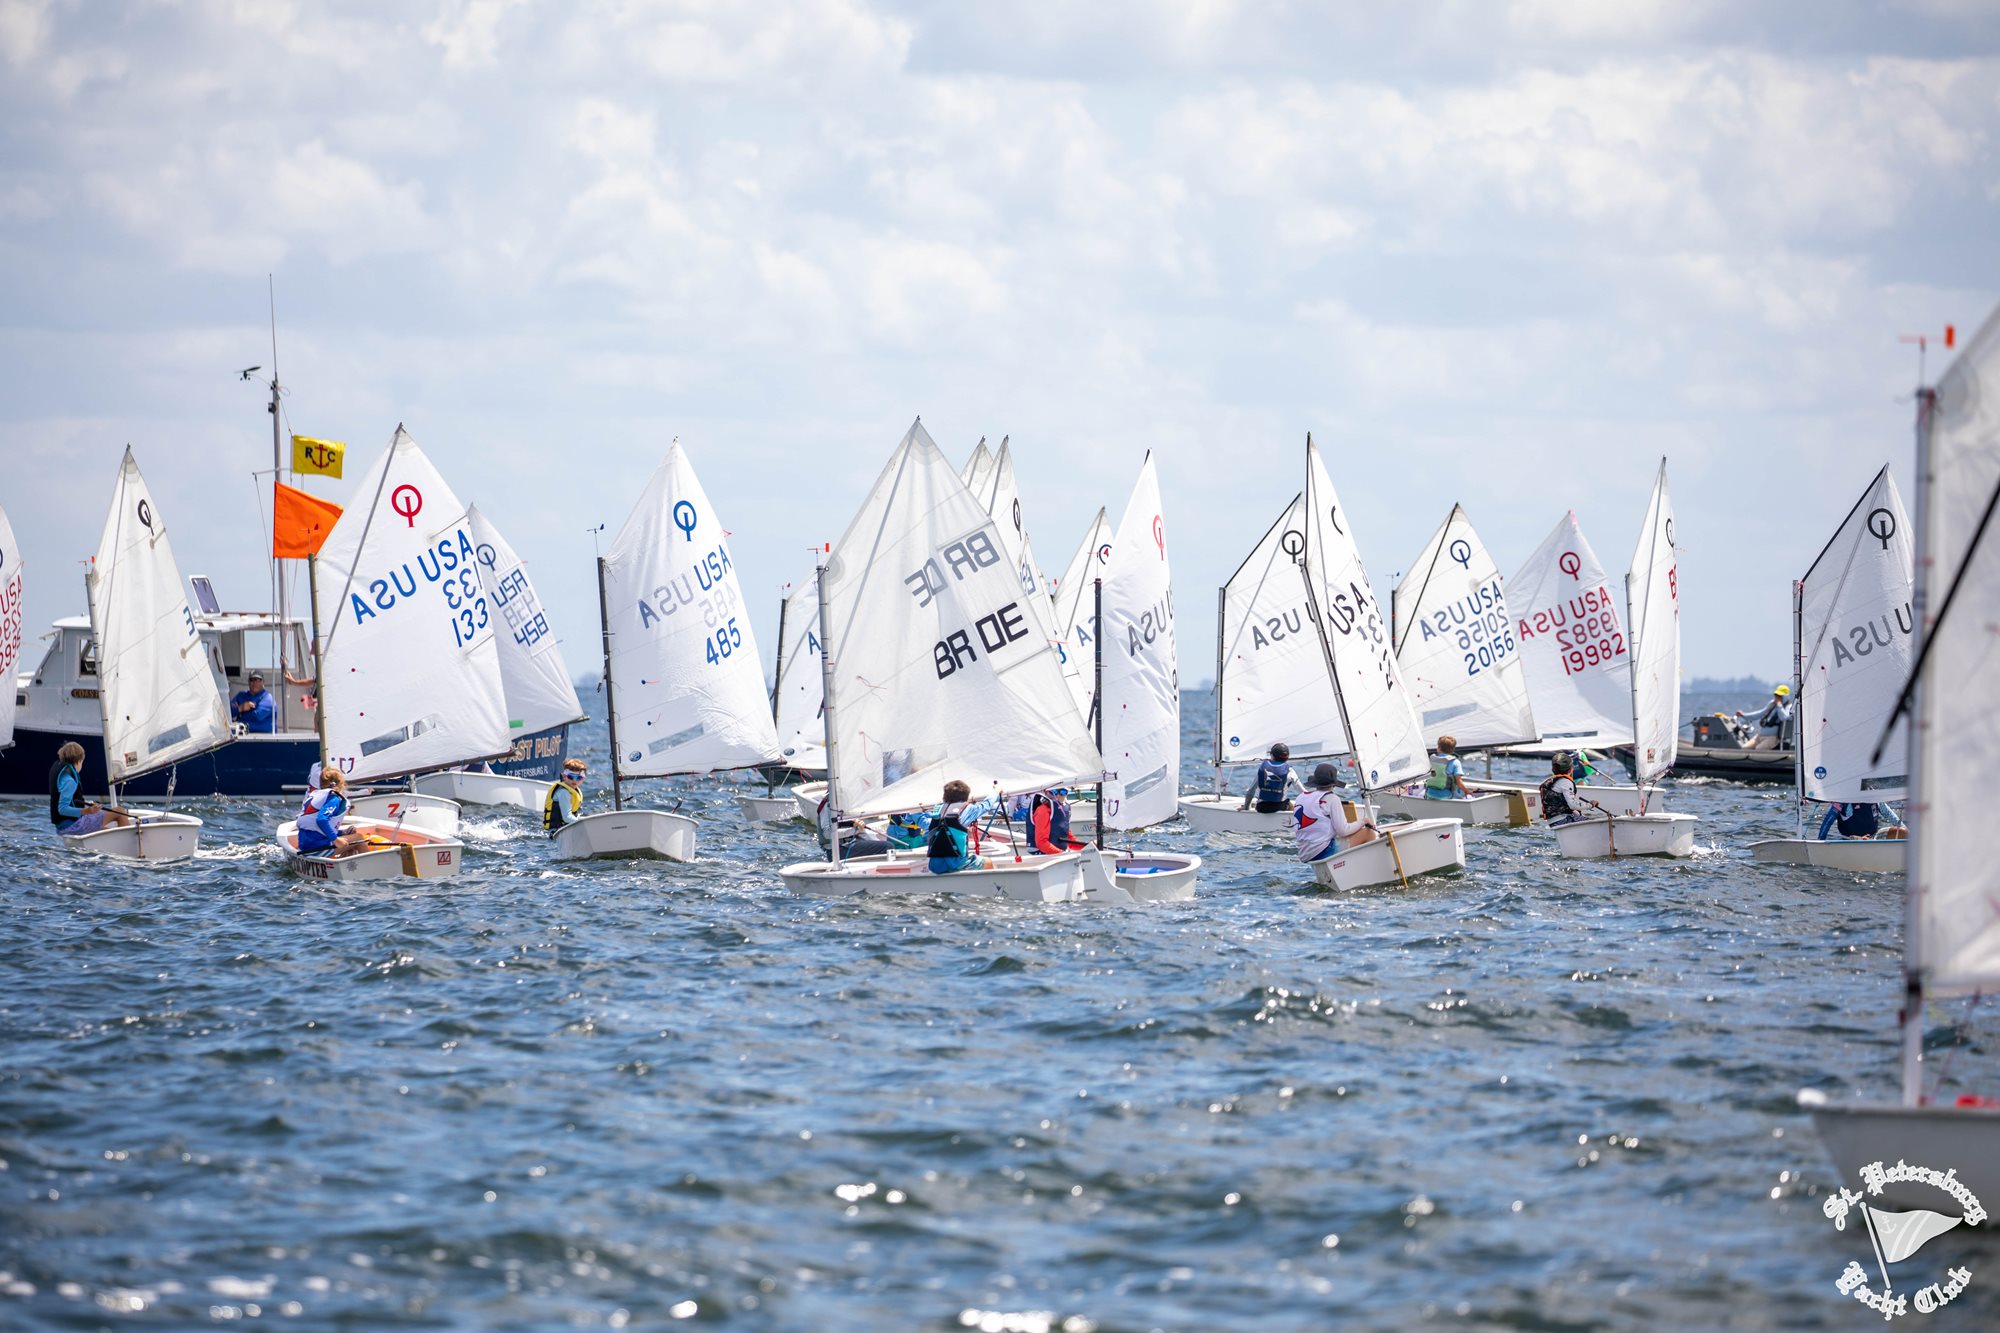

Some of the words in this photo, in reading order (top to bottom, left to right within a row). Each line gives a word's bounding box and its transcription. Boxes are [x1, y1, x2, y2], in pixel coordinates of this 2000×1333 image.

[417, 529, 474, 582] USA
[693, 544, 732, 591] USA
[491, 569, 528, 608] USA
[1327, 582, 1369, 635] USA
[1467, 581, 1503, 615] USA
[1570, 586, 1612, 620] USA
[452, 597, 489, 648] 133
[514, 612, 549, 647] 458
[705, 617, 741, 665] 485
[933, 629, 978, 680] BR
[975, 602, 1029, 654] DE
[1464, 630, 1515, 676] 20156
[1562, 633, 1626, 676] 19982
[535, 735, 562, 758] PILOT
